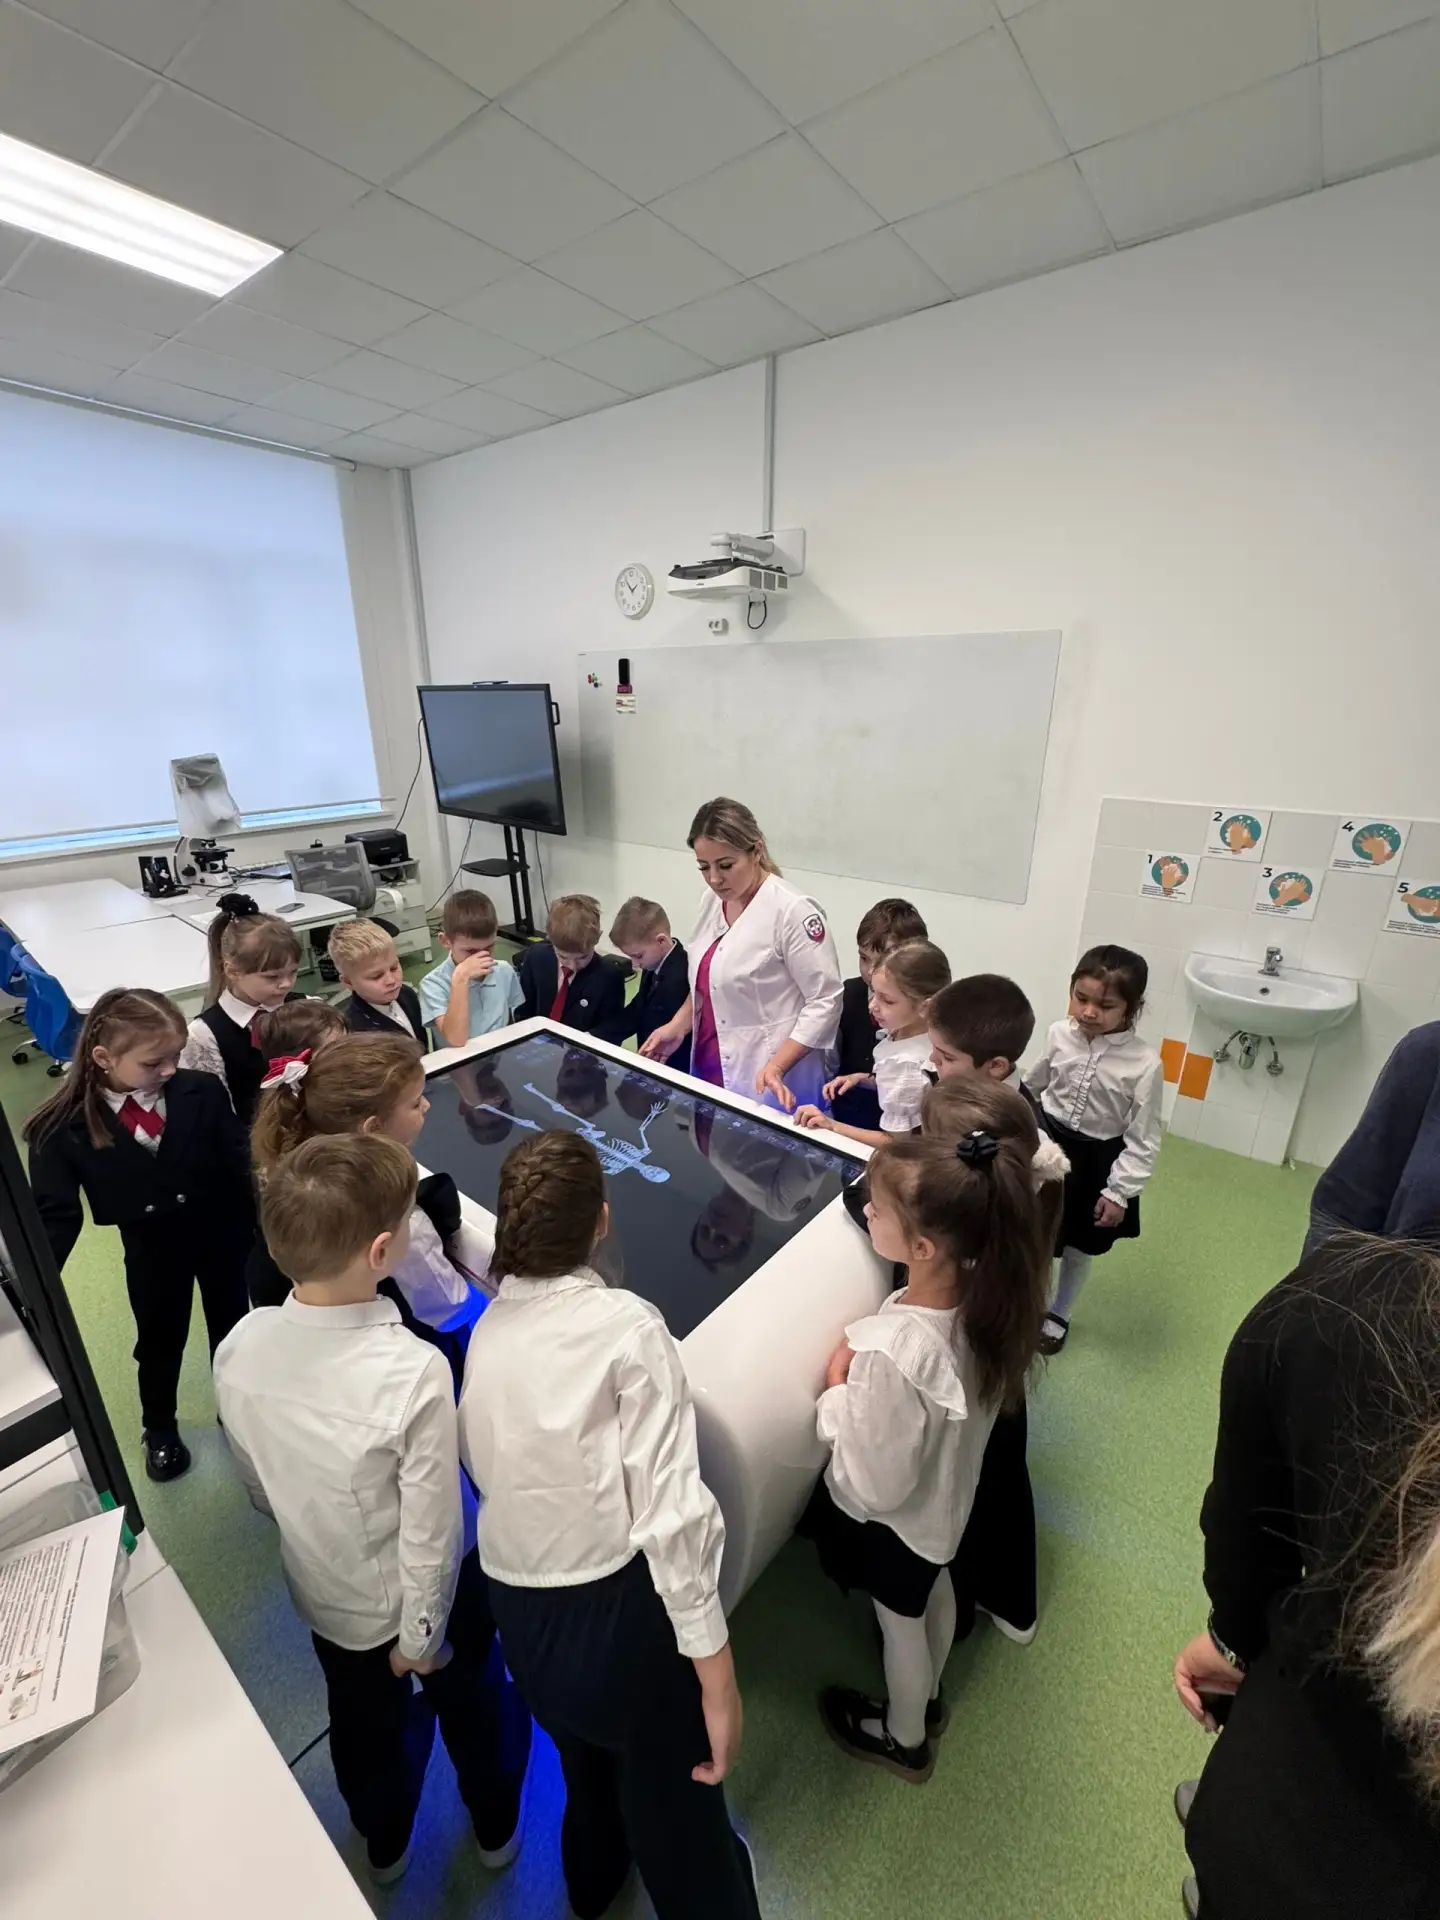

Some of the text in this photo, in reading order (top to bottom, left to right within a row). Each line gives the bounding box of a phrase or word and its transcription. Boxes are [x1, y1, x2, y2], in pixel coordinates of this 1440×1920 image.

[1213, 811, 1223, 822] 2
[1341, 821, 1354, 832] 4
[1147, 854, 1153, 864] 1
[1262, 867, 1273, 878] 3
[1397, 882, 1410, 893] 5
